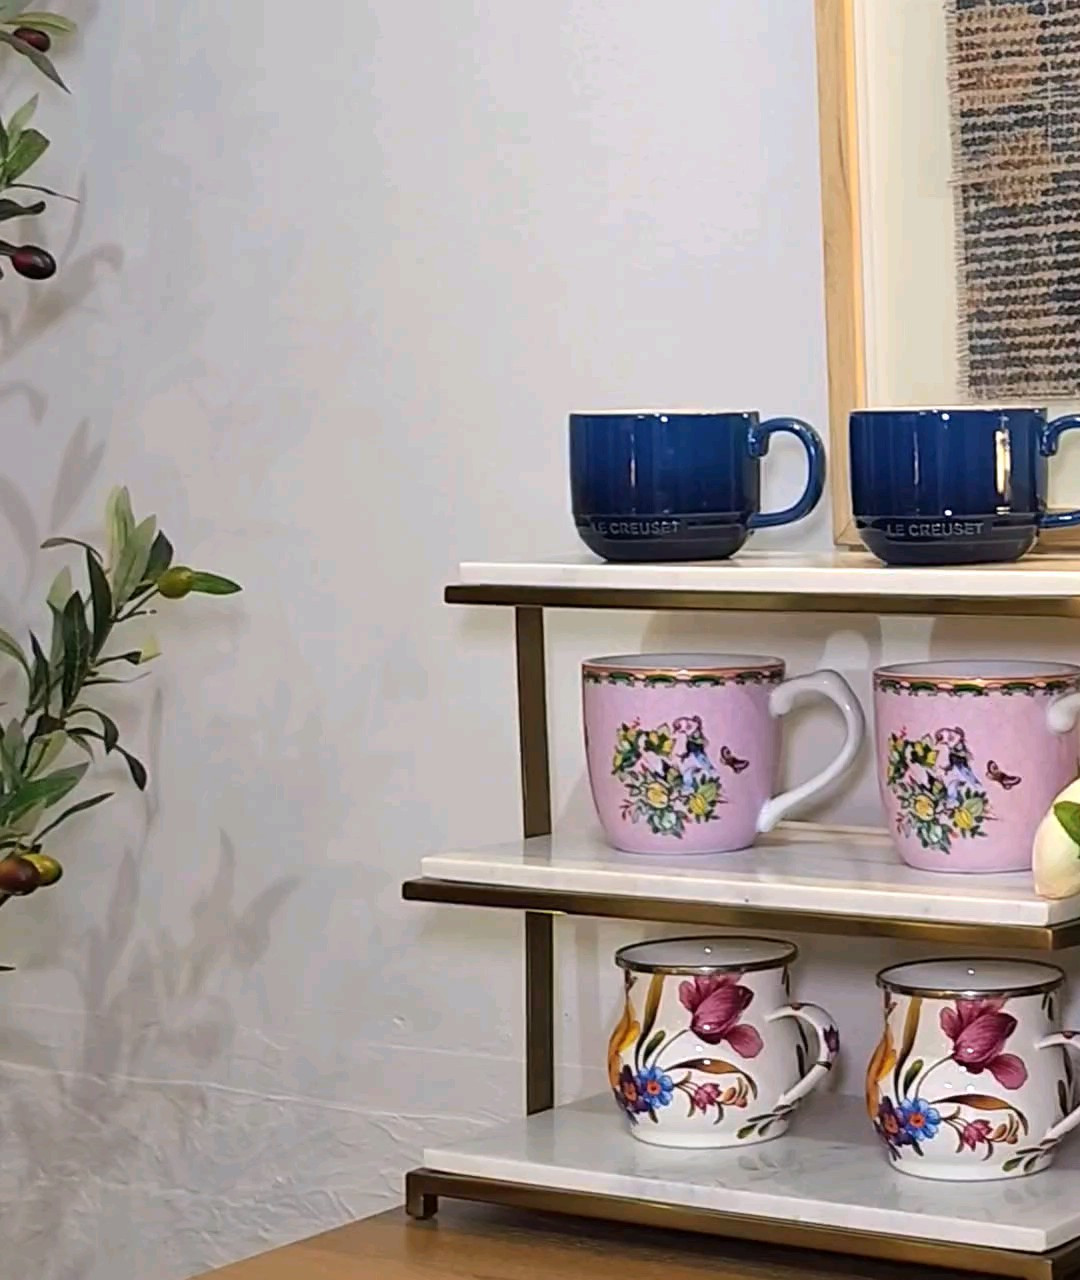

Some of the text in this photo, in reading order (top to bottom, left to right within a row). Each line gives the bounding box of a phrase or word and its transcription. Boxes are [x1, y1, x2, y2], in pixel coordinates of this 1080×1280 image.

[591, 520, 681, 536] LE CREUSET
[887, 522, 985, 537] LE CREUSET
